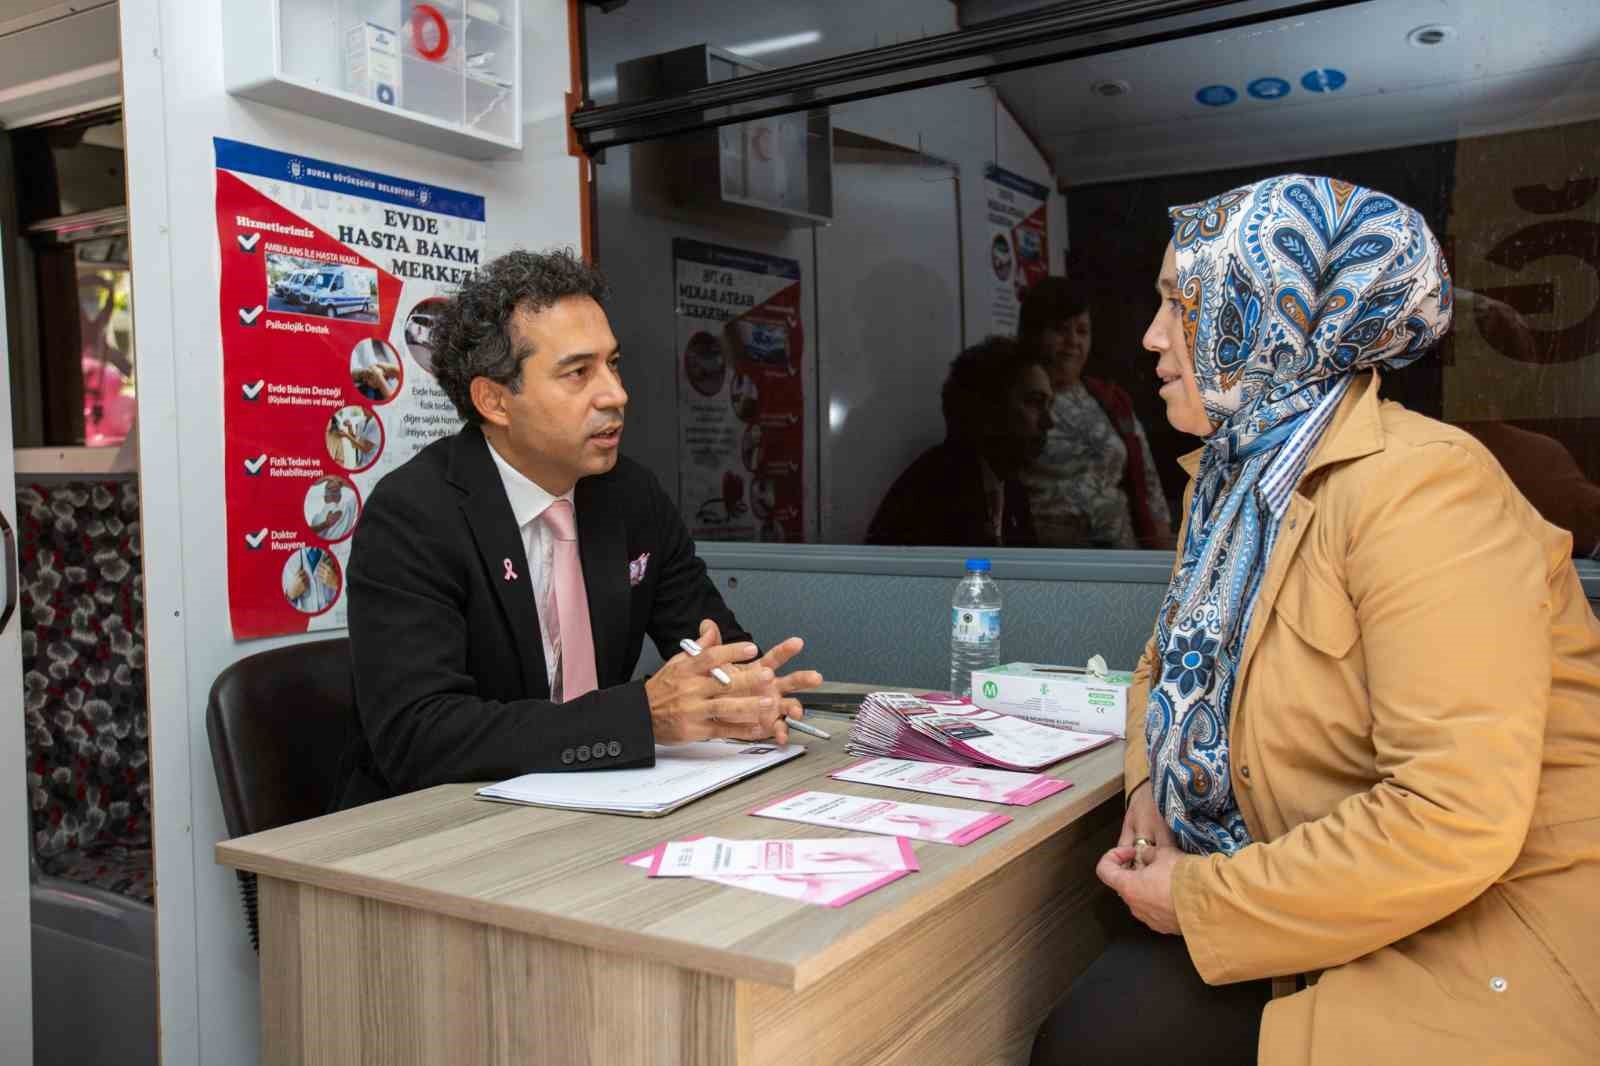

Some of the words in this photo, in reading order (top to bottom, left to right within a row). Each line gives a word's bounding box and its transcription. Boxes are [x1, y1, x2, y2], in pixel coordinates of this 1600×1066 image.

[306, 168, 331, 180] BURSA
[236, 215, 315, 239] Hizmetlerimiz
[384, 209, 438, 235] EVDE
[264, 242, 303, 257] AMBULANS
[315, 250, 338, 262] HASTA
[338, 225, 410, 253] HASTA
[416, 238, 479, 265] BAKIM
[265, 319, 304, 333] Psikolojik
[304, 323, 330, 335] Destek
[267, 383, 287, 394] Evde
[287, 384, 311, 395] Bakım
[311, 385, 341, 398] Desteği
[269, 456, 287, 467] Fizik
[287, 456, 311, 467] Tedavi
[311, 458, 321, 466] ve
[269, 467, 324, 479] Rehabilitasyon
[271, 530, 298, 540] Doktor
[984, 682, 997, 697] M
